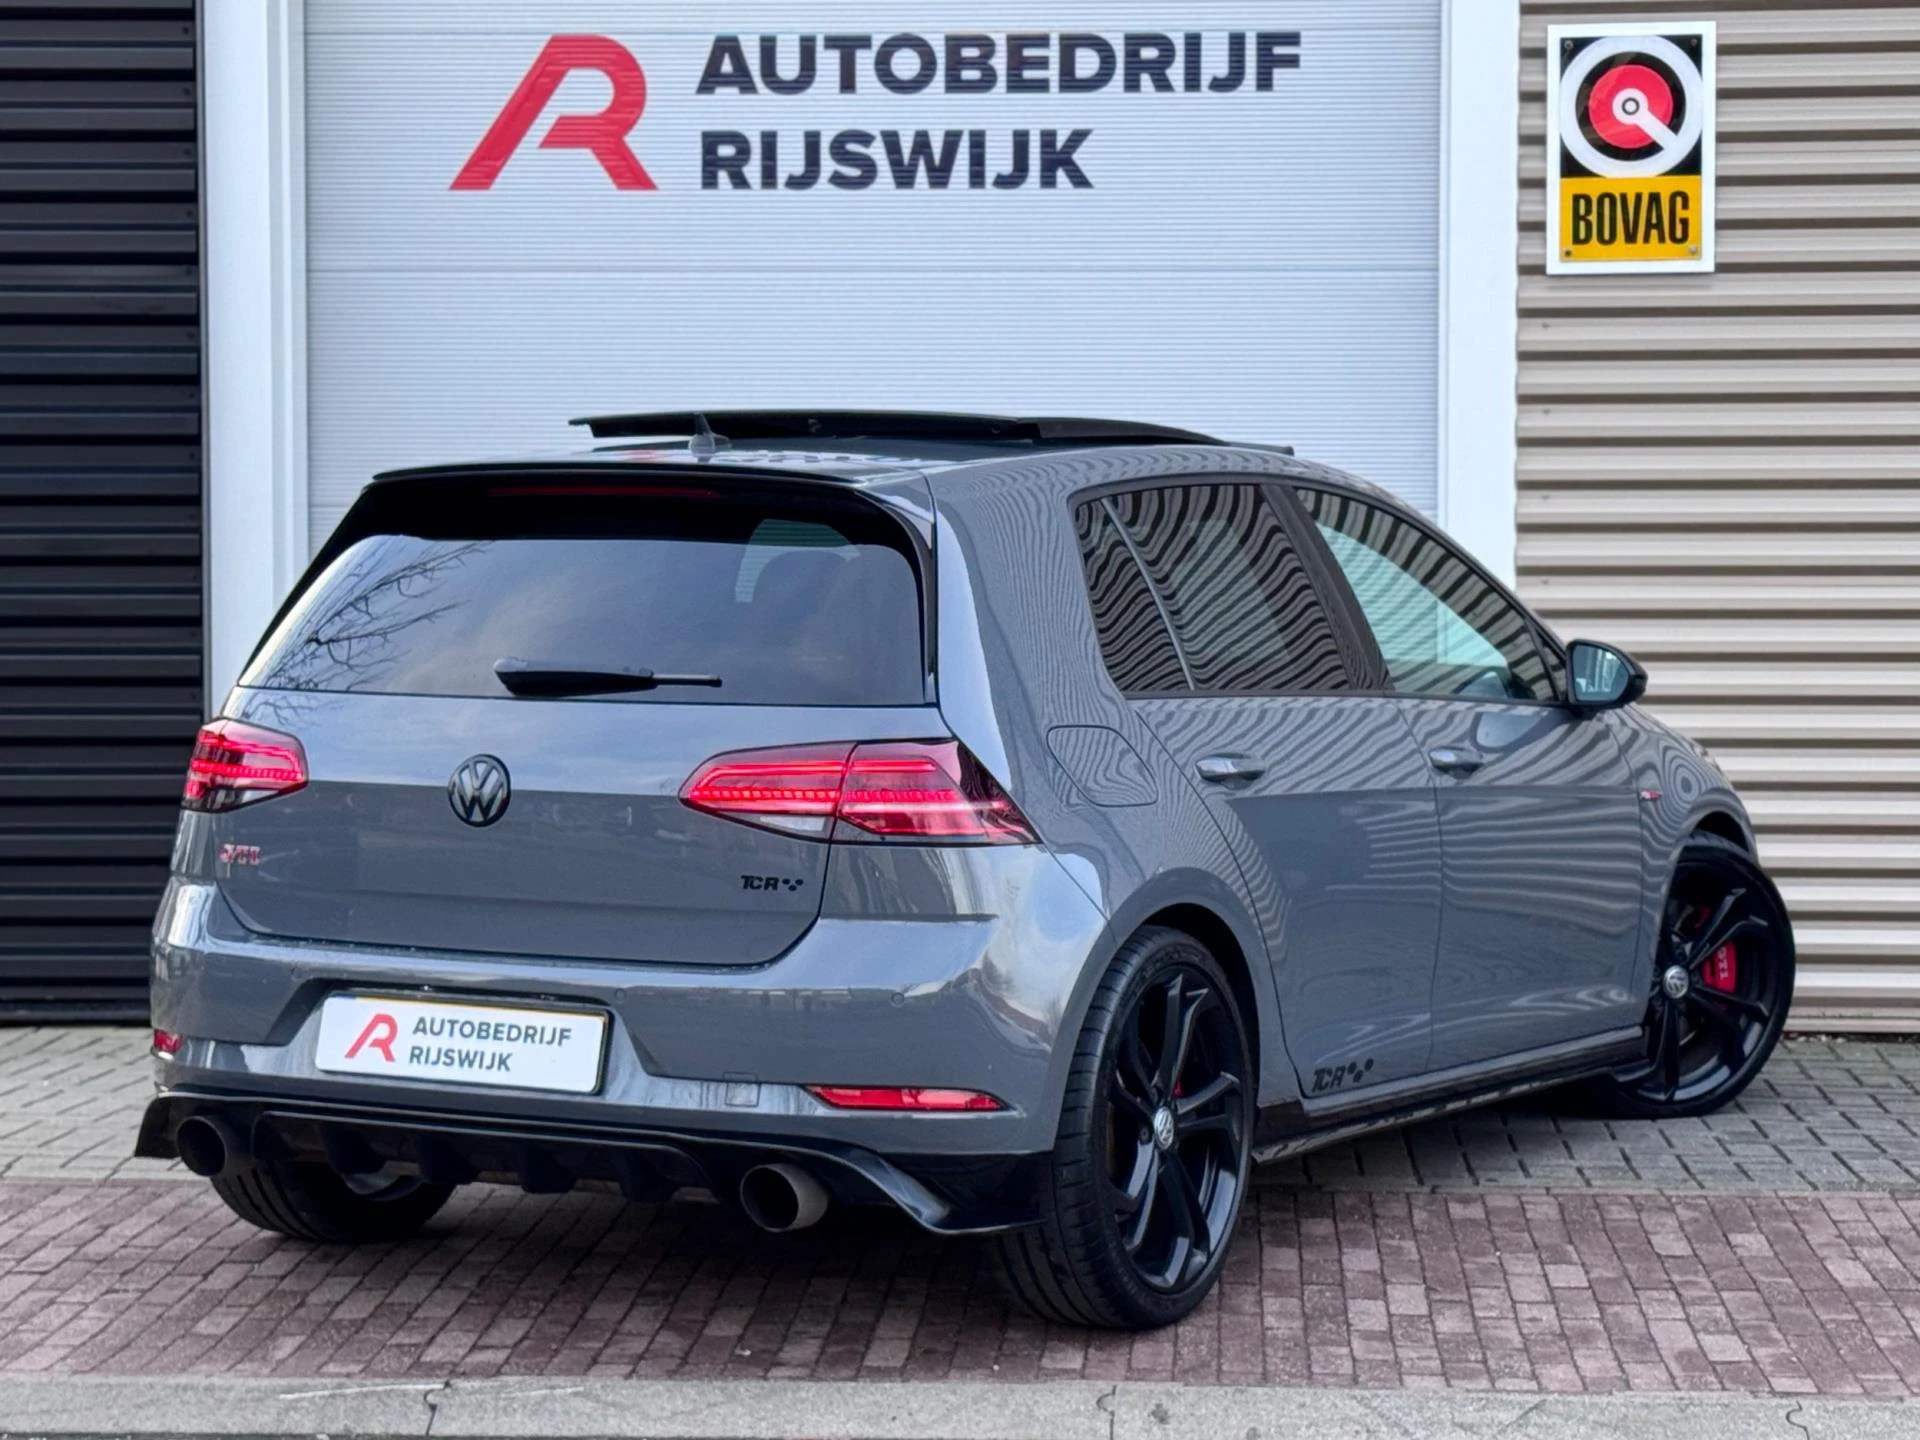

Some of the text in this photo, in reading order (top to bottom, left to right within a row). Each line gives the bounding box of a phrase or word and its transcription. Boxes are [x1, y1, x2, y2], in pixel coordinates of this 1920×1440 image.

[696, 31, 1301, 95] AUTOBEDRIJF
[701, 129, 1093, 191] RIJSWIJK
[1571, 191, 1690, 245] BOVAG
[411, 1016, 573, 1047] AUTOBEDRIJF
[408, 1046, 513, 1072] RIJSWIJK
